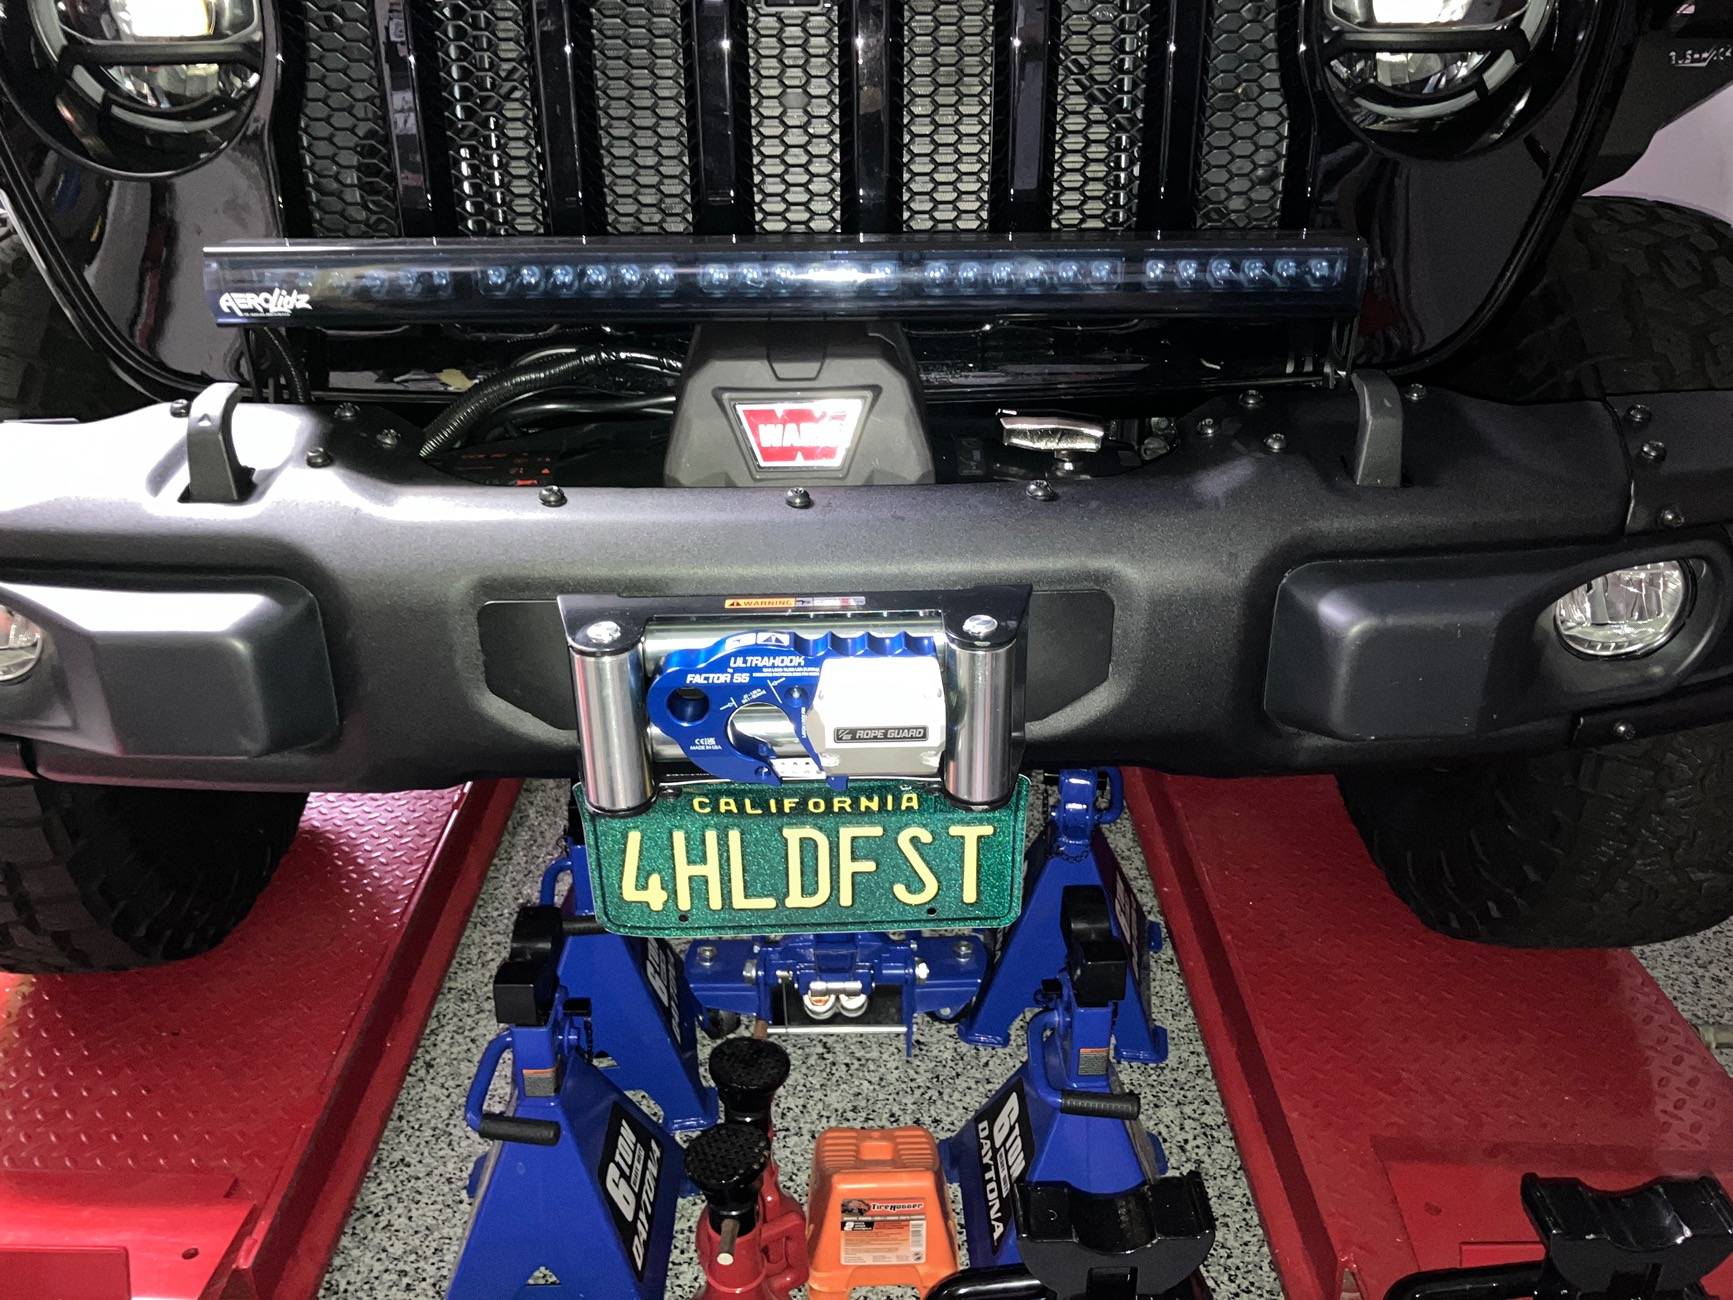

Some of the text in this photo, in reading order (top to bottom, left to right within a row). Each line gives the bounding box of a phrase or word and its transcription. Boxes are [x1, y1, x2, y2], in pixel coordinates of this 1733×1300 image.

[686, 673, 731, 683] FACTOR
[733, 672, 750, 683] 55
[729, 656, 805, 667] ULTRAHOOK
[855, 730, 885, 739] ROPE
[887, 728, 924, 738] GUARD
[693, 792, 919, 814] CALIFORNIA
[621, 825, 994, 912] 4HLDFST
[606, 1118, 637, 1222] 6 TON
[993, 1091, 1026, 1183] 6 TON
[632, 1138, 661, 1272] DAYTONA
[978, 1120, 1004, 1246] DAYTONA
